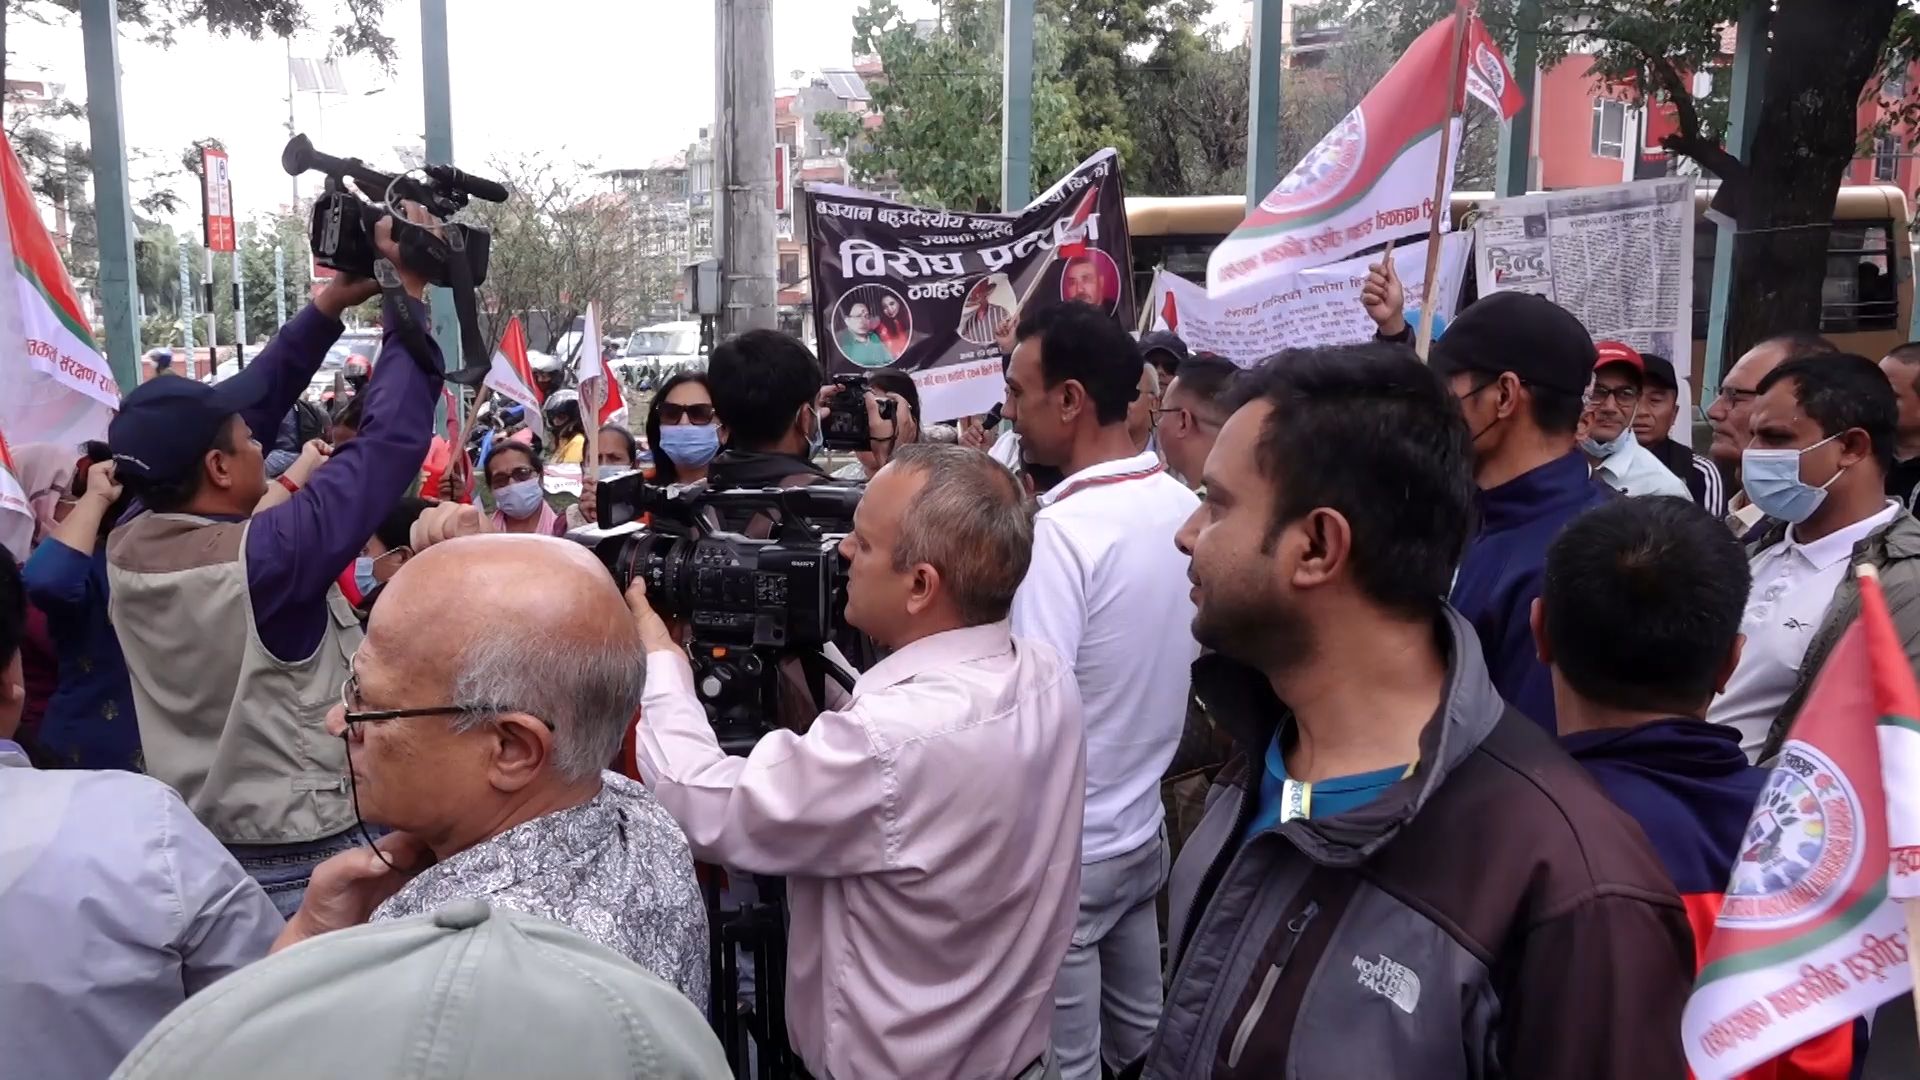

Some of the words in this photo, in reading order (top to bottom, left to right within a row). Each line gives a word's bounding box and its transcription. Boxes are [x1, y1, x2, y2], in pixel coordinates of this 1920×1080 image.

[839, 238, 966, 279] विरोध
[59, 350, 97, 387] संरक्षण
[790, 560, 815, 568] SONY
[1352, 955, 1402, 989] NORTH
[1358, 971, 1399, 998] FACE
